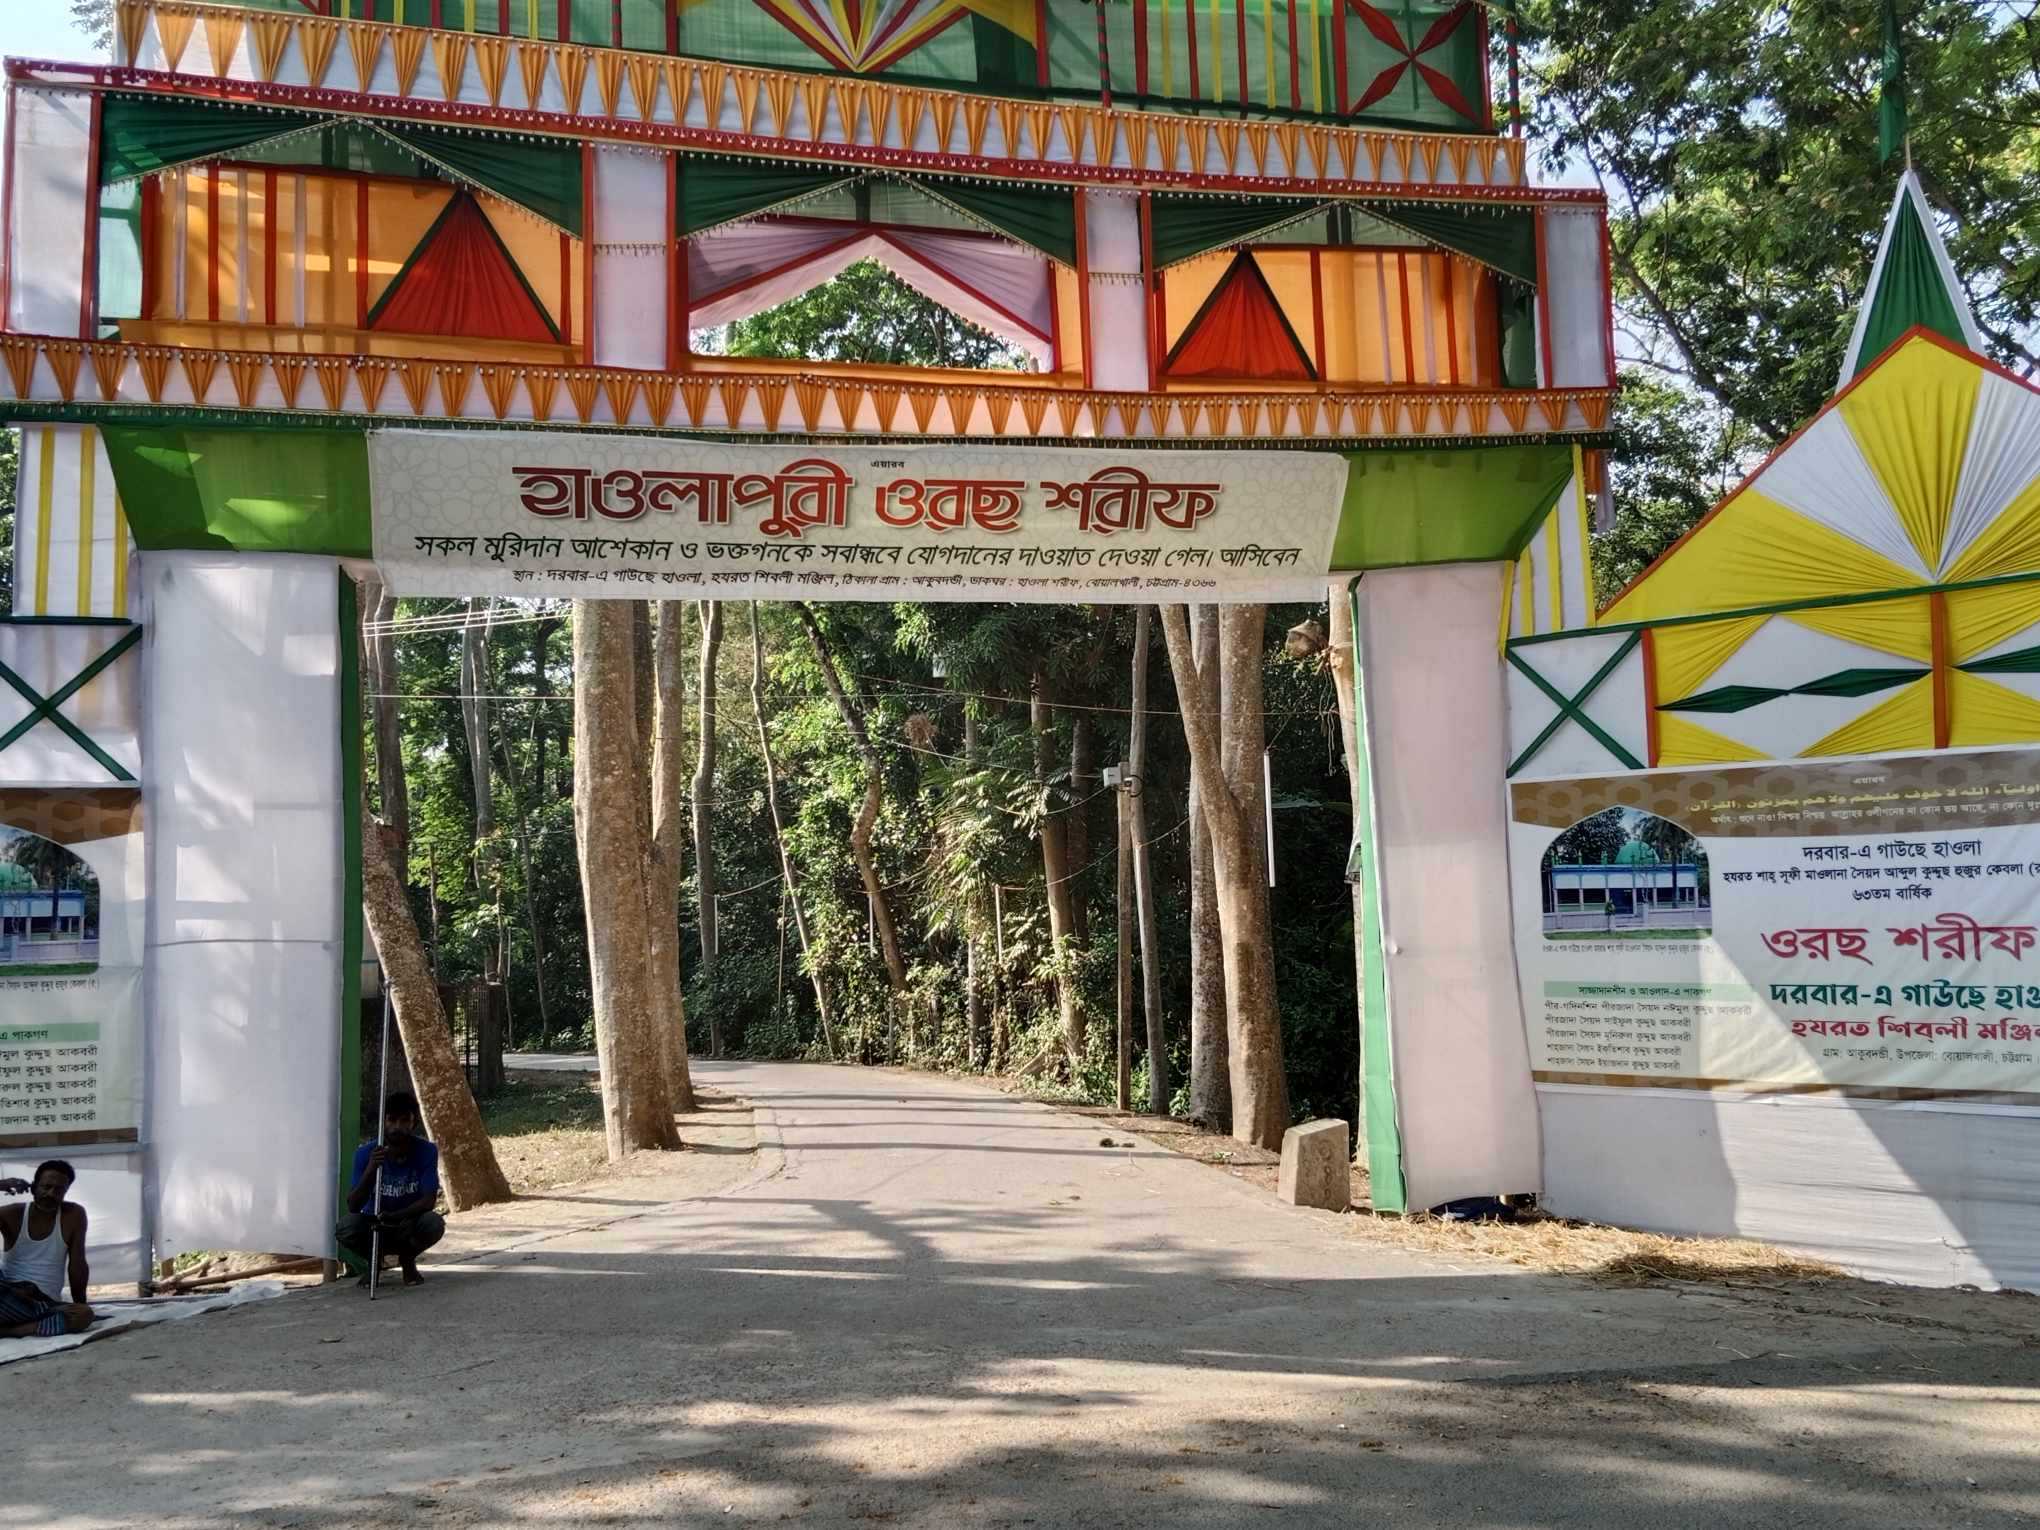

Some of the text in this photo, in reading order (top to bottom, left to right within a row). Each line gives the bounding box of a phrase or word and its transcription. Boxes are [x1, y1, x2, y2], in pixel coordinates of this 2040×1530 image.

[511, 458, 1221, 538] হাওলাপুরী ওরছ শরীফ
[415, 532, 1302, 568] সকল মুরিদান আশেকান ও ভক্তগনকে সবান্ধবে যোগদানের দাওয়াত দেওয়া গেল। আসিবেন
[546, 568, 607, 583] দরবার-এ
[613, 570, 655, 584] গাউছে
[711, 572, 749, 585] হযরত
[1802, 839, 1982, 861] দরবার-এ গাউছে হাওলা
[1723, 871, 1753, 883] হযরত
[1806, 868, 1847, 881] মাওলানা
[1986, 864, 2023, 875] কেবলা
[1896, 883, 1932, 900] বার্ষিক
[1761, 913, 2038, 966] ওরছ শরীফ
[1770, 984, 1892, 1007] দরবার-এ
[1903, 979, 1987, 1011] গাউছে
[1792, 1019, 1870, 1038] হযরত
